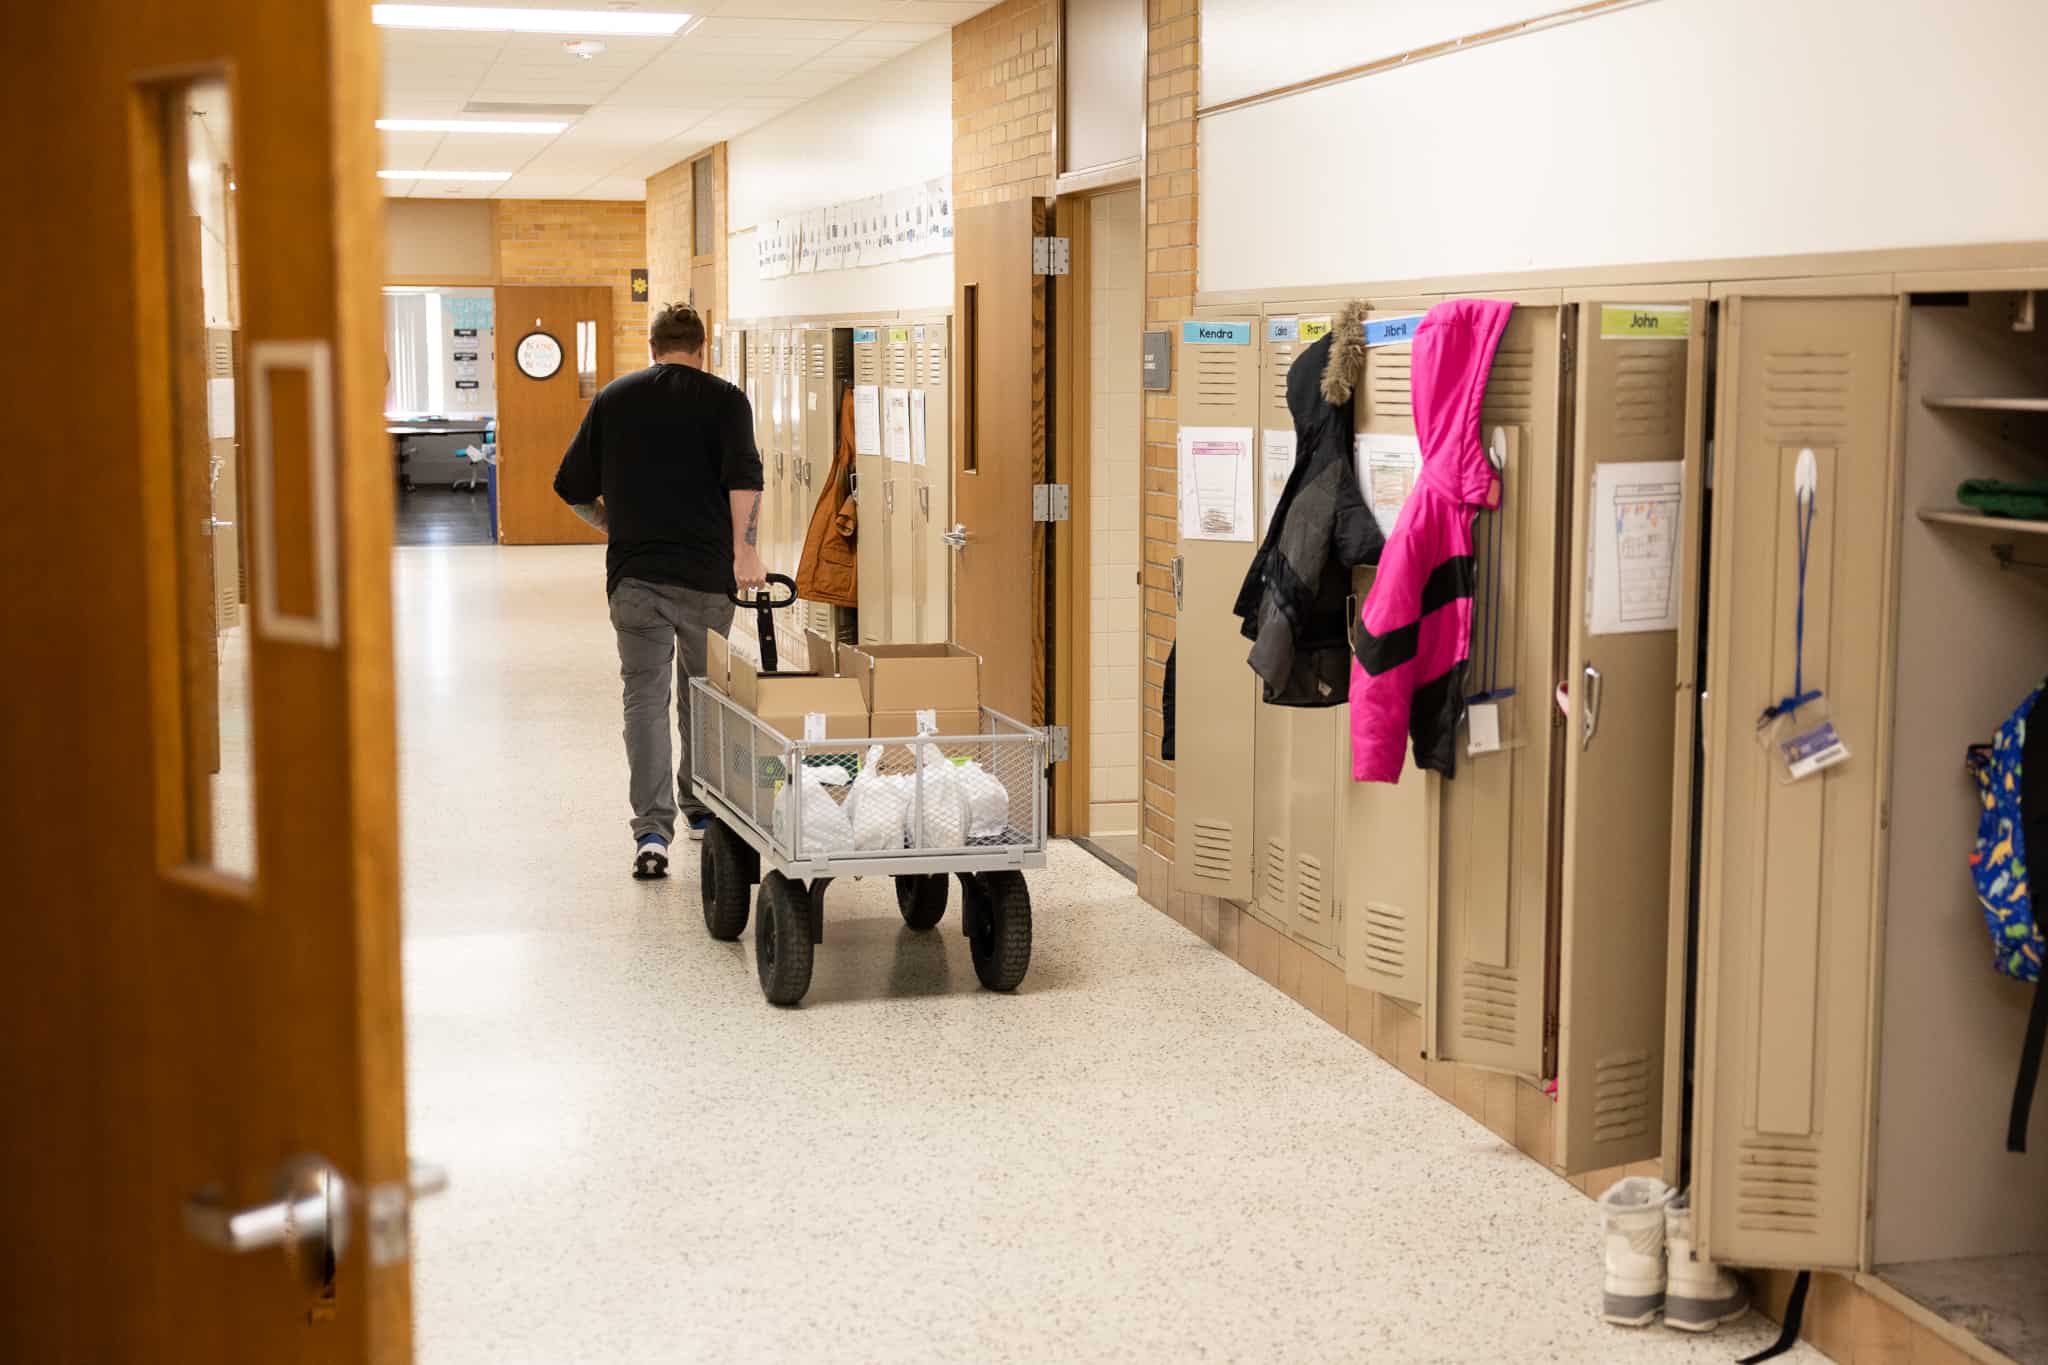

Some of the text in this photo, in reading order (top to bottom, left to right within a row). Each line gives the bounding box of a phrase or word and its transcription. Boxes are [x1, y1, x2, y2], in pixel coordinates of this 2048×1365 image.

[1629, 311, 1658, 328] John
[1199, 327, 1233, 339] Kendra
[1383, 323, 1407, 337] Jibril
